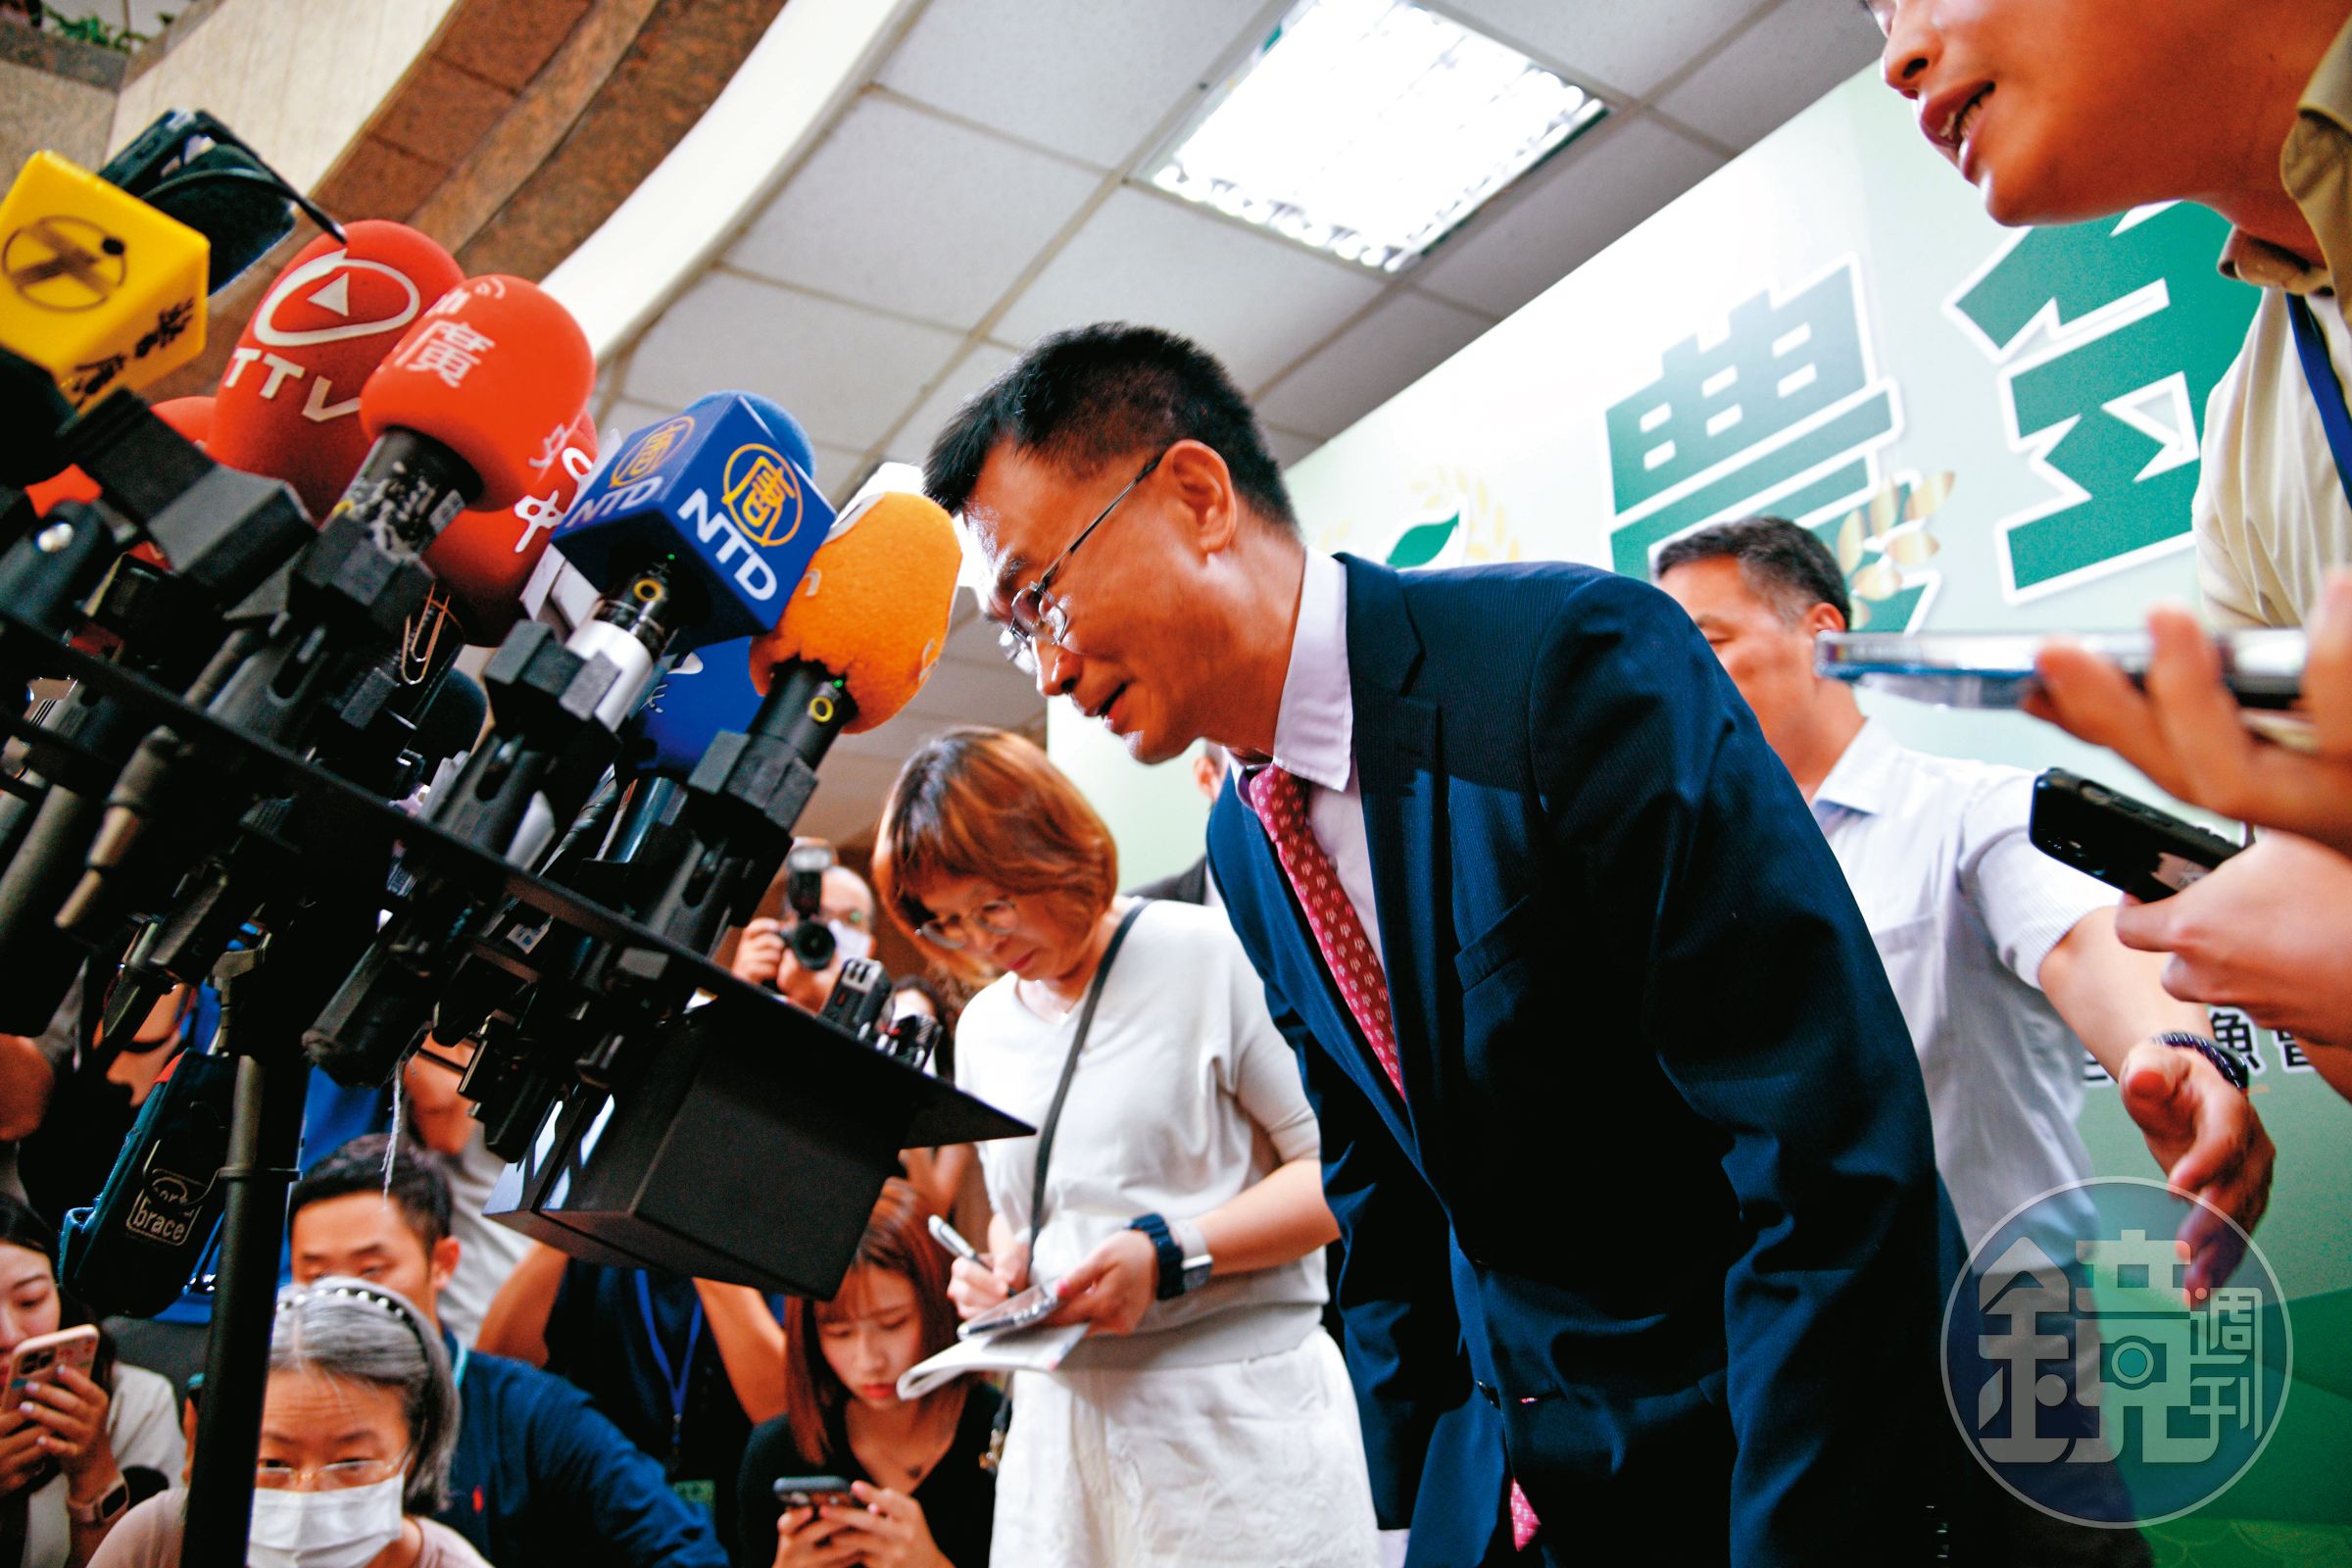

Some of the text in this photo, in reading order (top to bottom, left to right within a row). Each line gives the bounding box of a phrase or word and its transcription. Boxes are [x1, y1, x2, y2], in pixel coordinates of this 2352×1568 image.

[224, 346, 363, 423] TTV
[564, 475, 663, 529] NTD
[675, 487, 778, 601] NTD
[132, 1195, 186, 1242] brace
